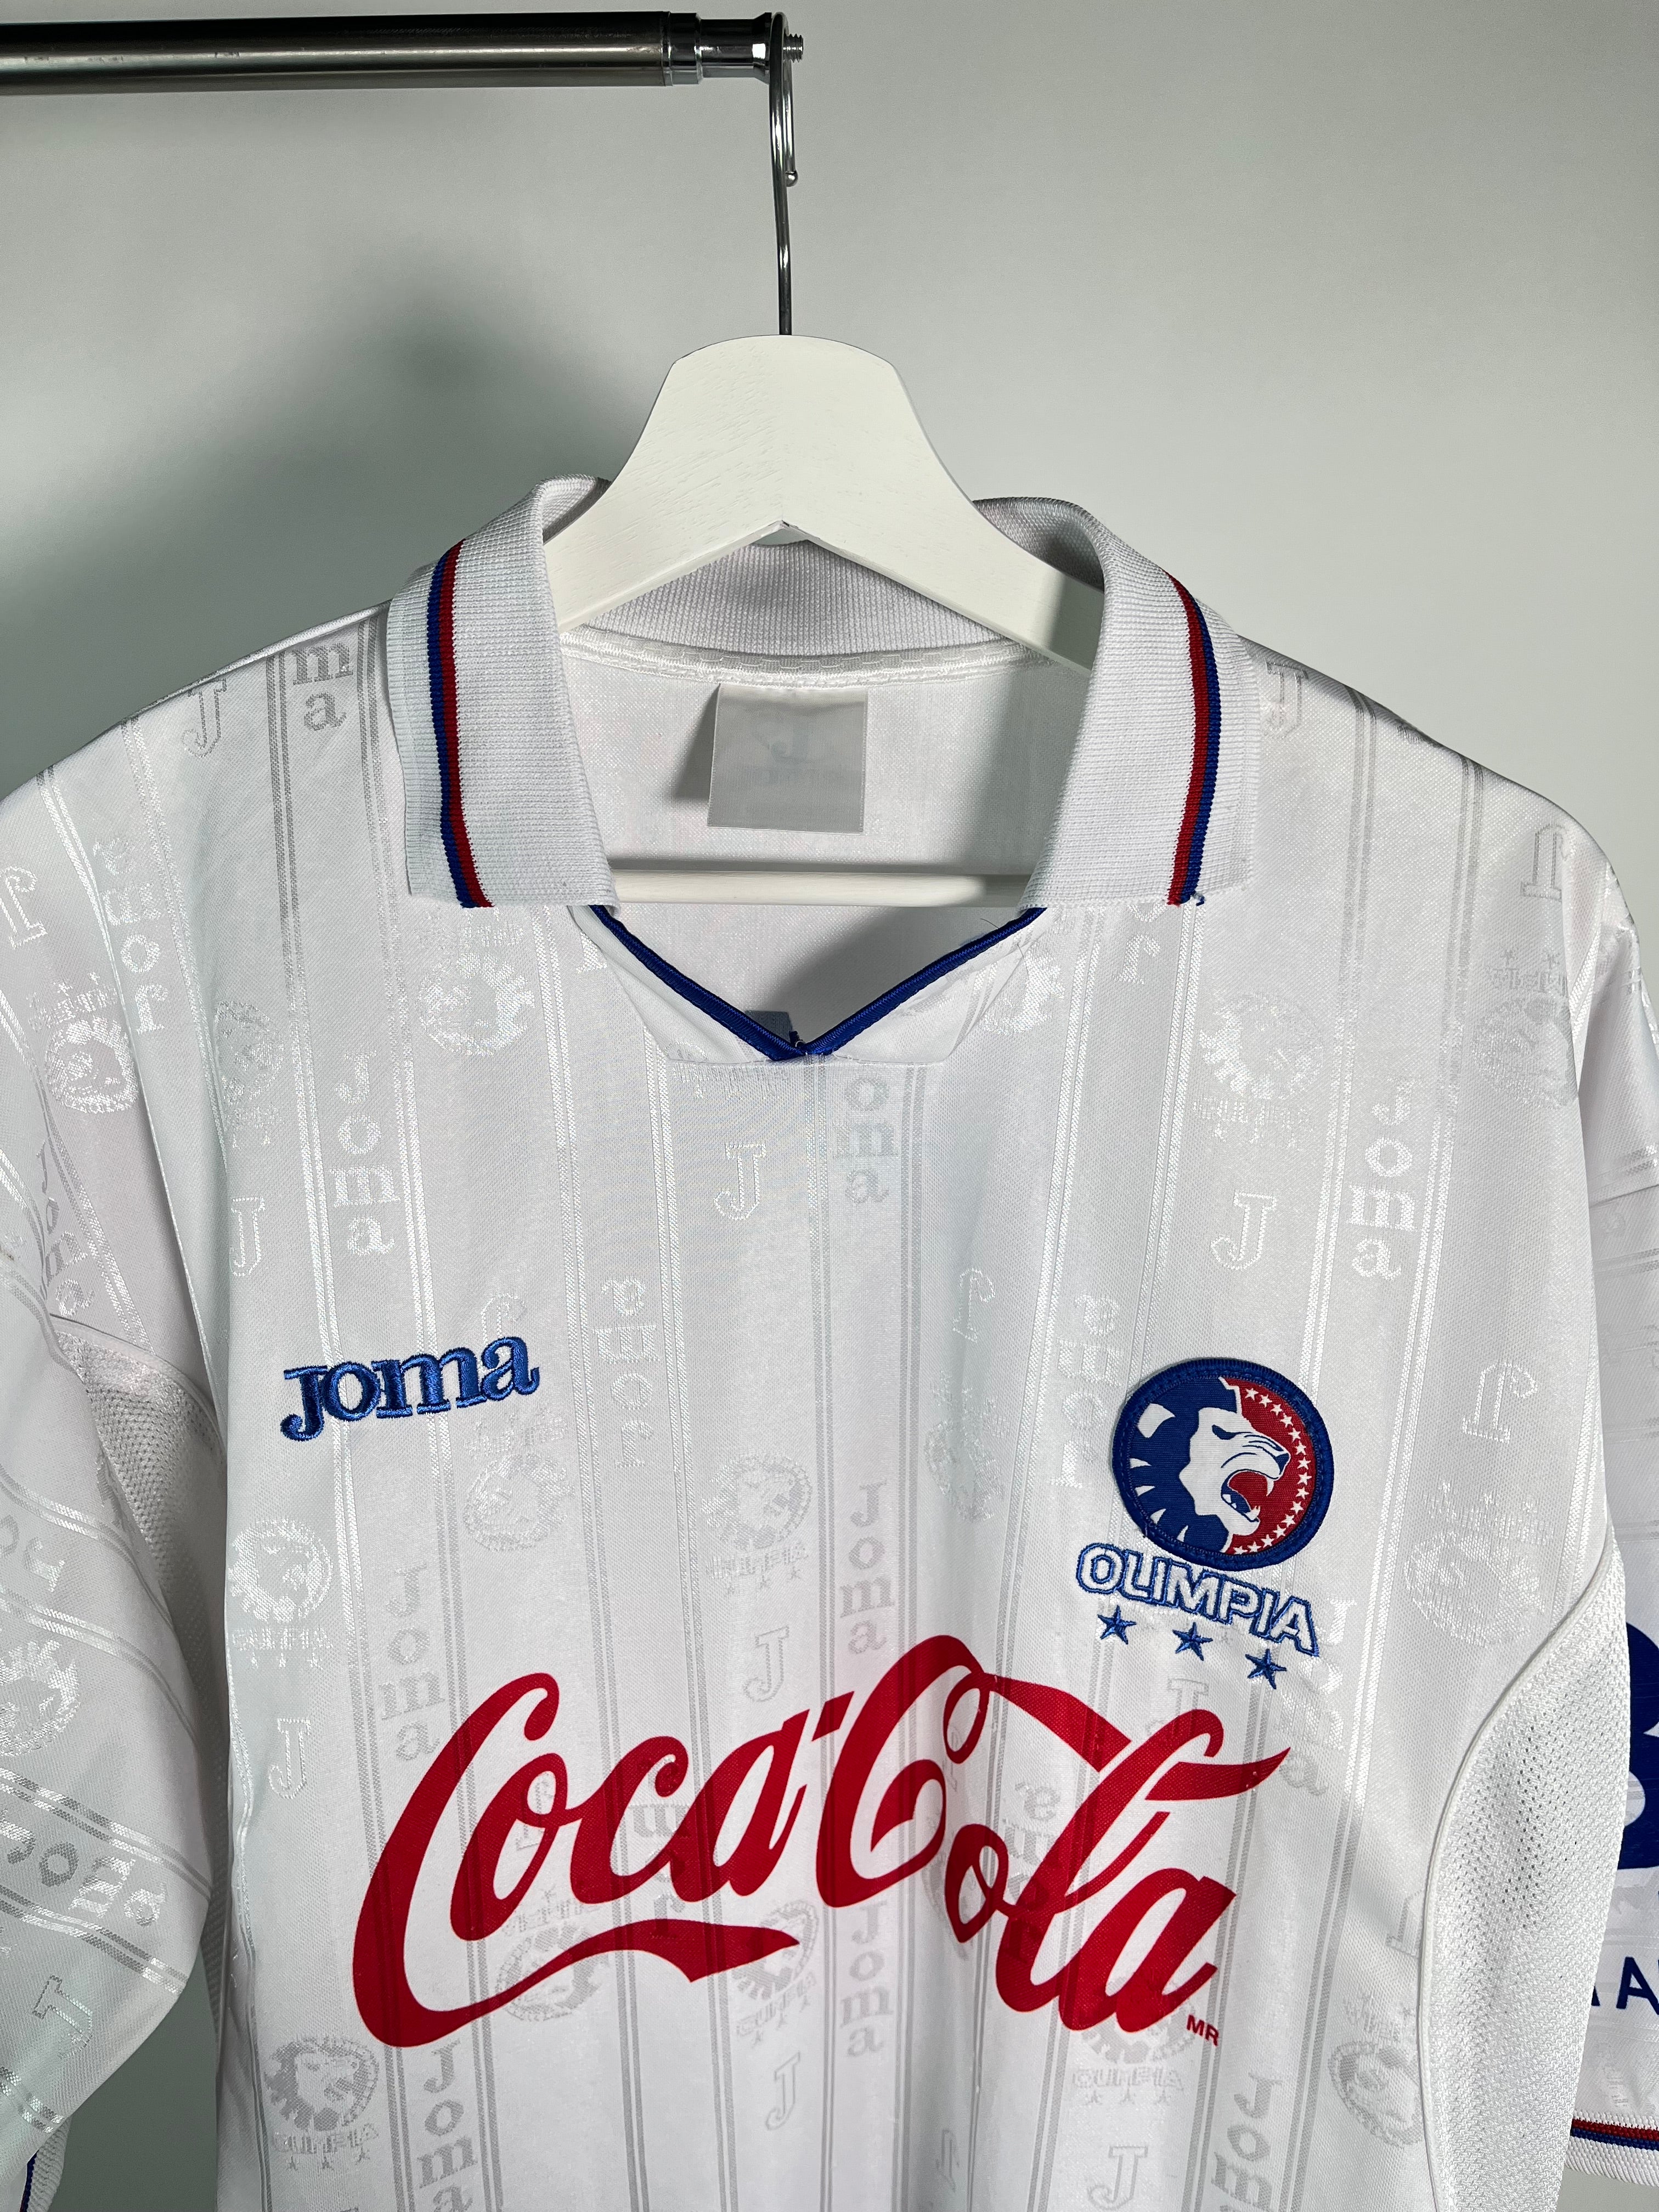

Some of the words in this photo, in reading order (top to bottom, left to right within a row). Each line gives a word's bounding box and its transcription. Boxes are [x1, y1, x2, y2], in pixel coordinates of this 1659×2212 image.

[281, 1336, 540, 1442] Joma
[1076, 1543, 1319, 1658] OLIMPIA
[353, 1635, 1290, 2048] Coca-Cola
[1186, 2014, 1220, 2046] MR
